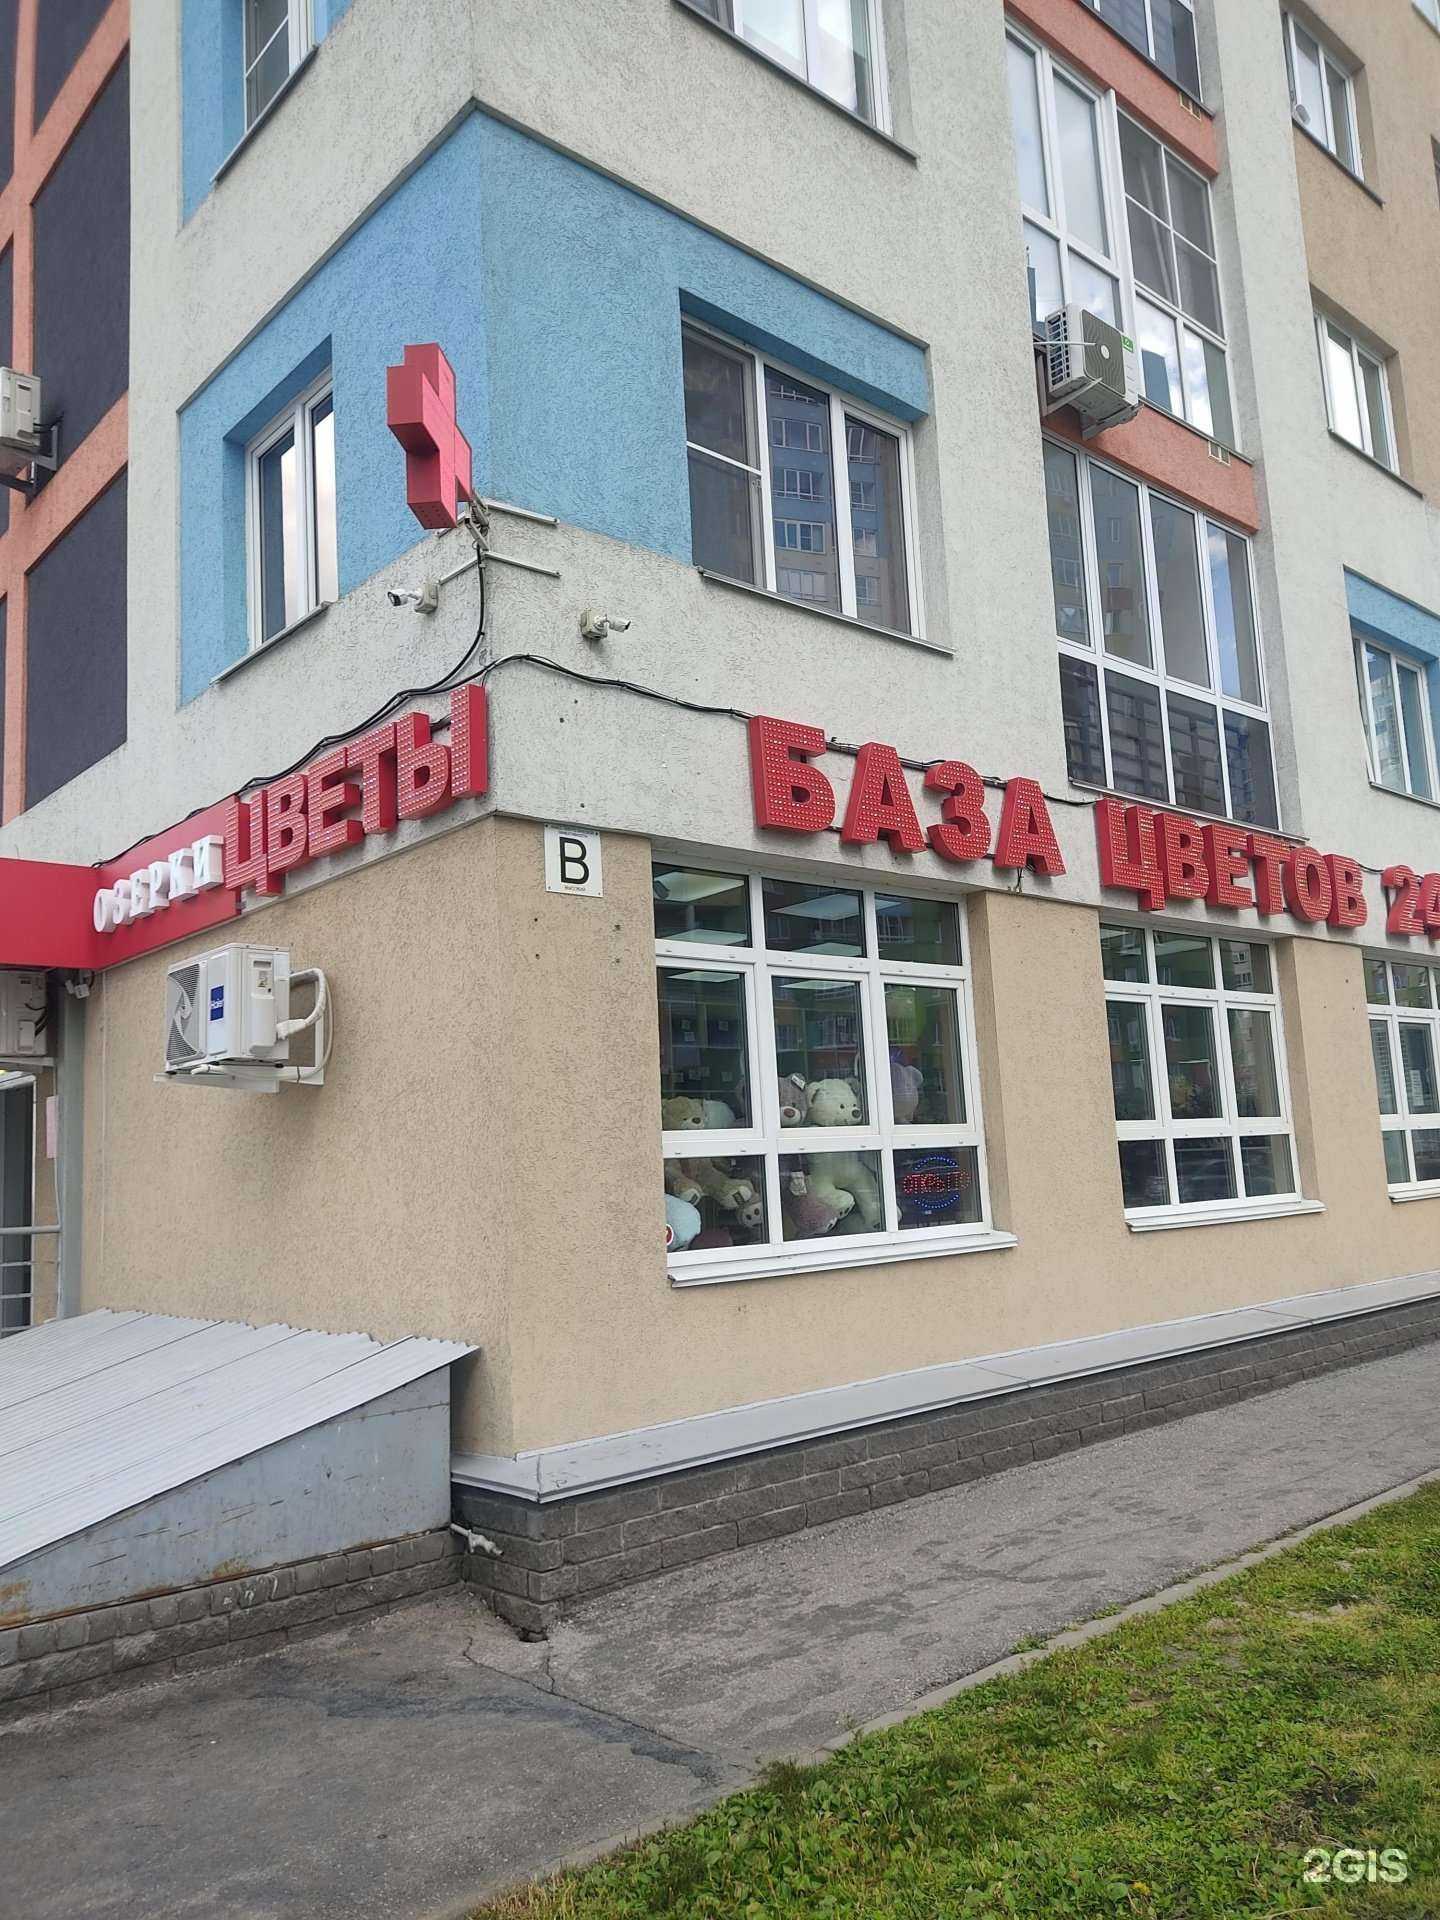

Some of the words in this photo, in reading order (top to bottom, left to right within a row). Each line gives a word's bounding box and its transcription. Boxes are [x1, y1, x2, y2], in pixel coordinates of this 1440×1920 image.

[93, 834, 225, 933] ОЗЕРКИ
[224, 683, 488, 896] ЦВЕТЫ
[748, 714, 1066, 876] БАЗА
[1095, 796, 1367, 930] ЦВЕТОВ
